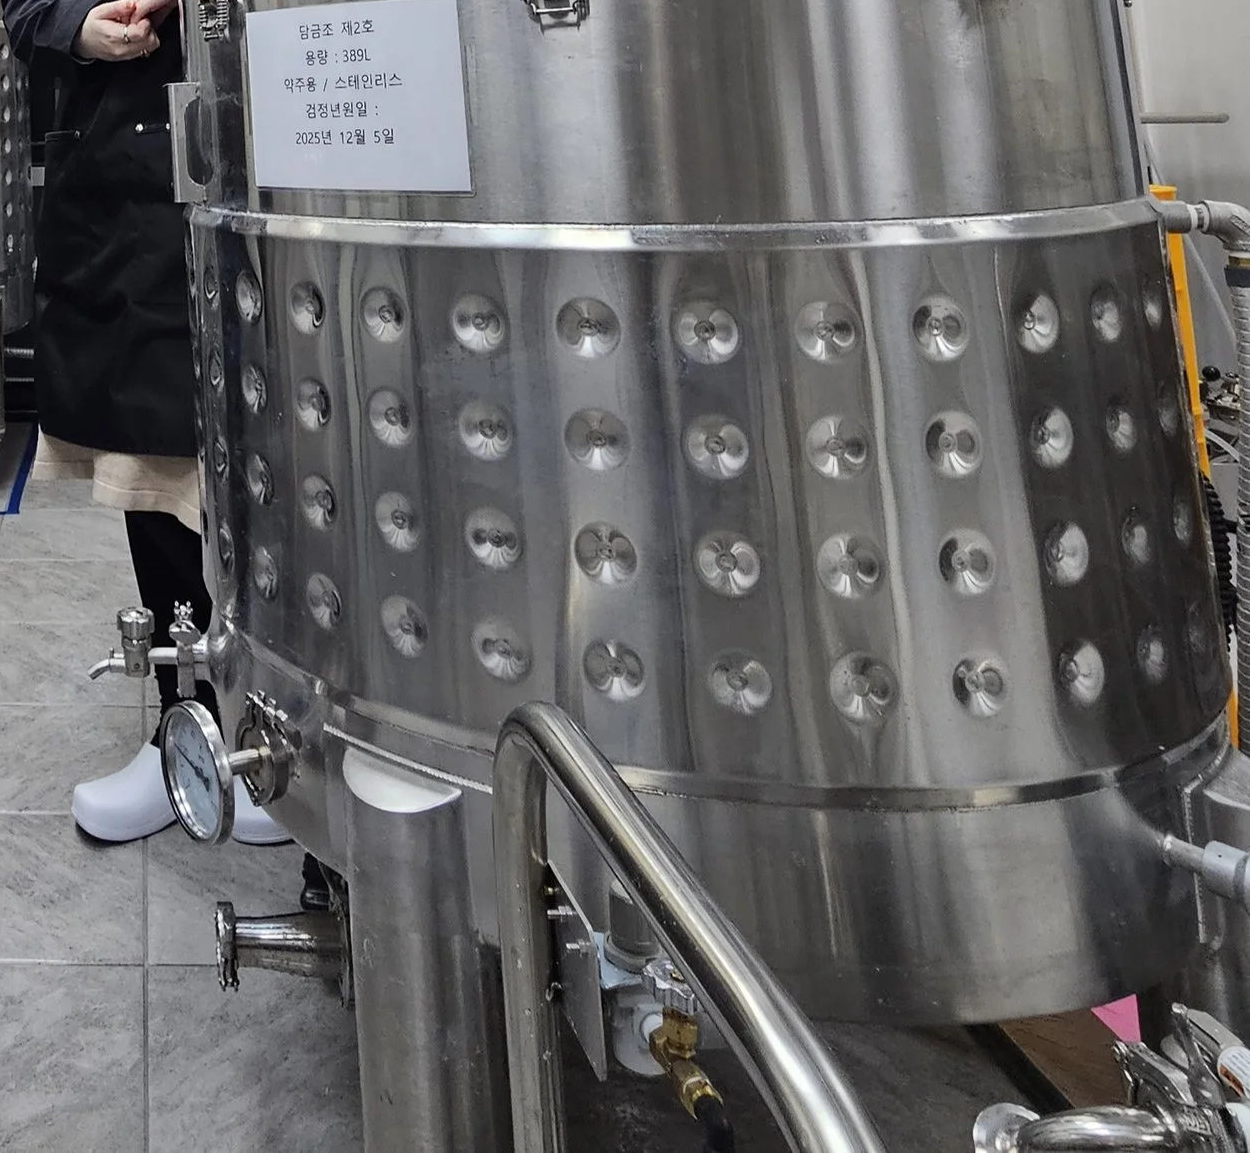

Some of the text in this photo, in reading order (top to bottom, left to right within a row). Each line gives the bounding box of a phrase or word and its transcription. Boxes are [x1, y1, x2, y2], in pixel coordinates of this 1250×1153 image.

[299, 19, 375, 41] 담금조 제2호
[305, 49, 329, 67] 용량
[342, 47, 372, 63] 389L
[283, 72, 403, 94] 약주용 / 스테인리스
[295, 127, 395, 146] 2025년 12월 5일
